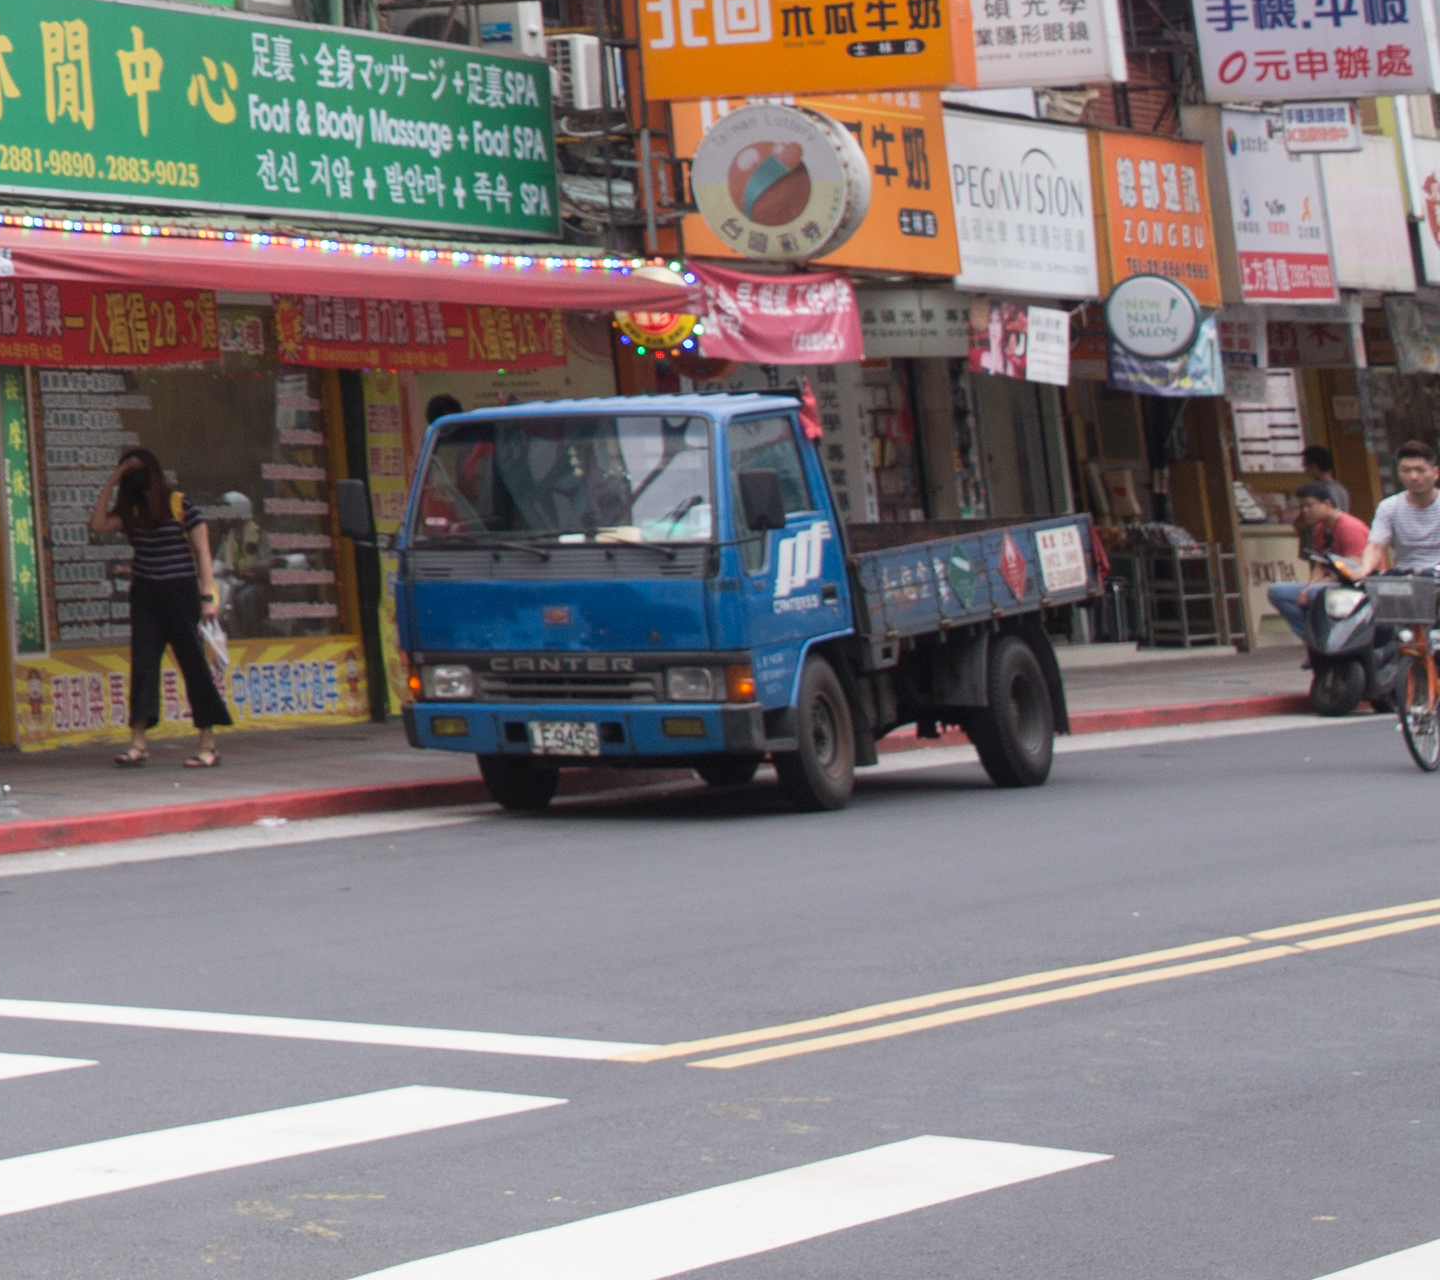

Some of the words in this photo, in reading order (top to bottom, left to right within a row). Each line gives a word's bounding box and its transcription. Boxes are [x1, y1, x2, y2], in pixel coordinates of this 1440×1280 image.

[316, 103, 362, 144] Body
[472, 121, 510, 157] Foot
[513, 126, 546, 163] SPA
[311, 154, 354, 200] 지압
[384, 163, 445, 209] 발안마
[521, 181, 553, 219] SPA
[952, 162, 1084, 219] PEGAVISION
[1123, 218, 1207, 250] ZONGBU
[1124, 296, 1162, 310] NEW
[1125, 310, 1164, 325] NAIL
[1128, 324, 1179, 340] SALON
[491, 656, 635, 674] CANTER
